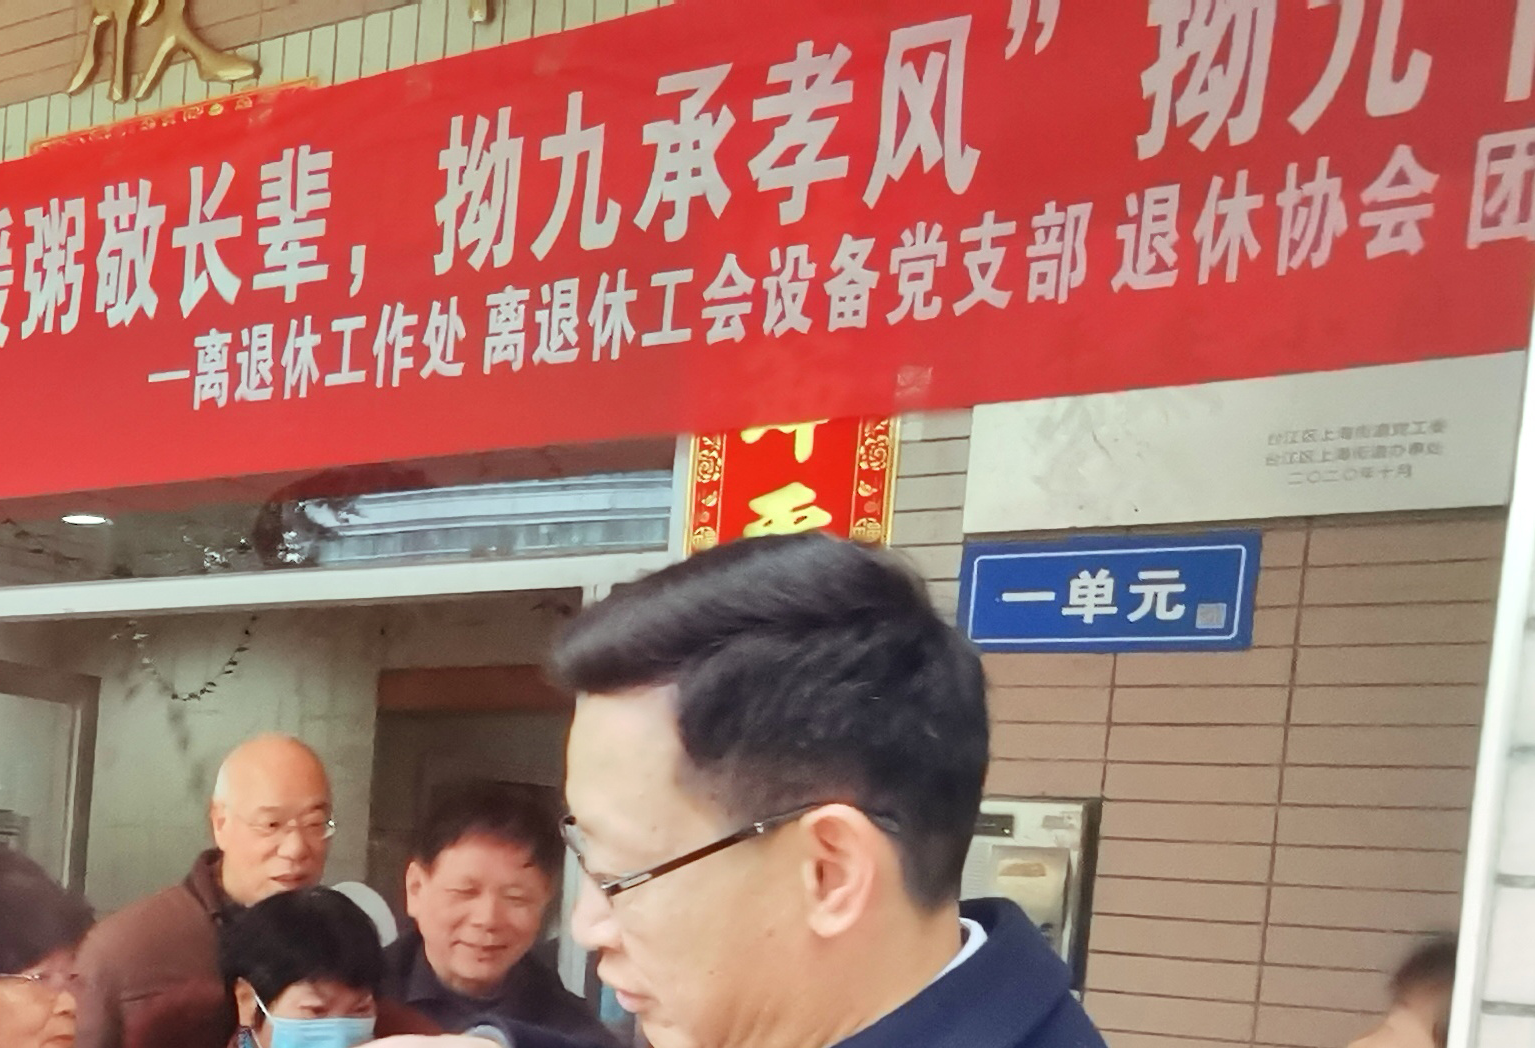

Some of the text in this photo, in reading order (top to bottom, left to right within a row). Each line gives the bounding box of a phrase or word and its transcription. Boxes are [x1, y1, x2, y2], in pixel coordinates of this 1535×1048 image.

[483, 201, 1087, 374] 离退休工会设备党支部
[1111, 144, 1440, 293] 退休协会
[1002, 568, 1186, 624] 一单元
